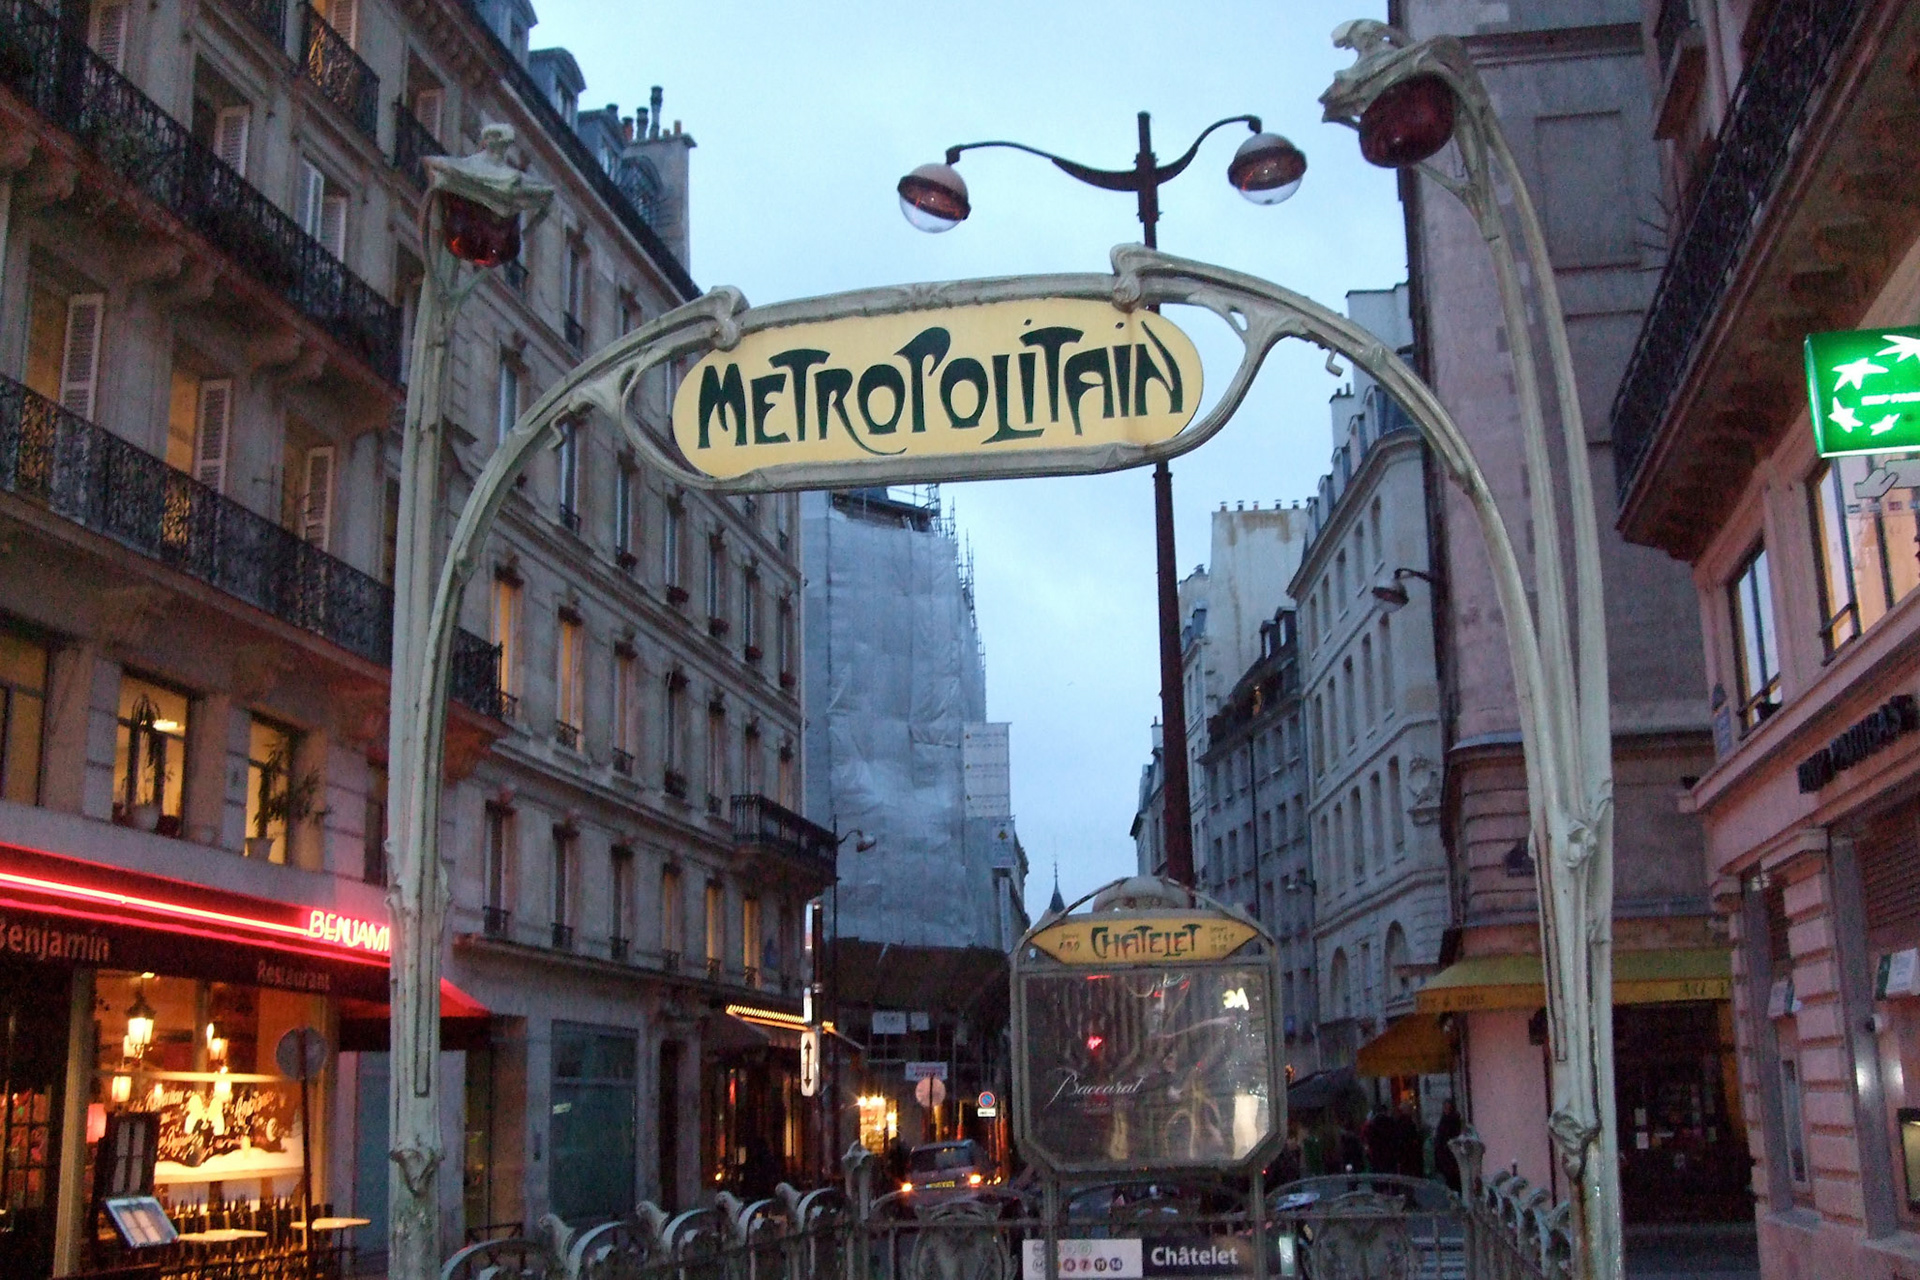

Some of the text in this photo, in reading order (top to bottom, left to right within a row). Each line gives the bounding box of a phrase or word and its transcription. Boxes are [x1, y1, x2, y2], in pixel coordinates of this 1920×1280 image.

[697, 318, 1184, 456] METROPOLITAIN
[257, 959, 331, 991] Restaurant
[1043, 1067, 1146, 1109] Baccarat
[1150, 1245, 1239, 1266] Châtelet
